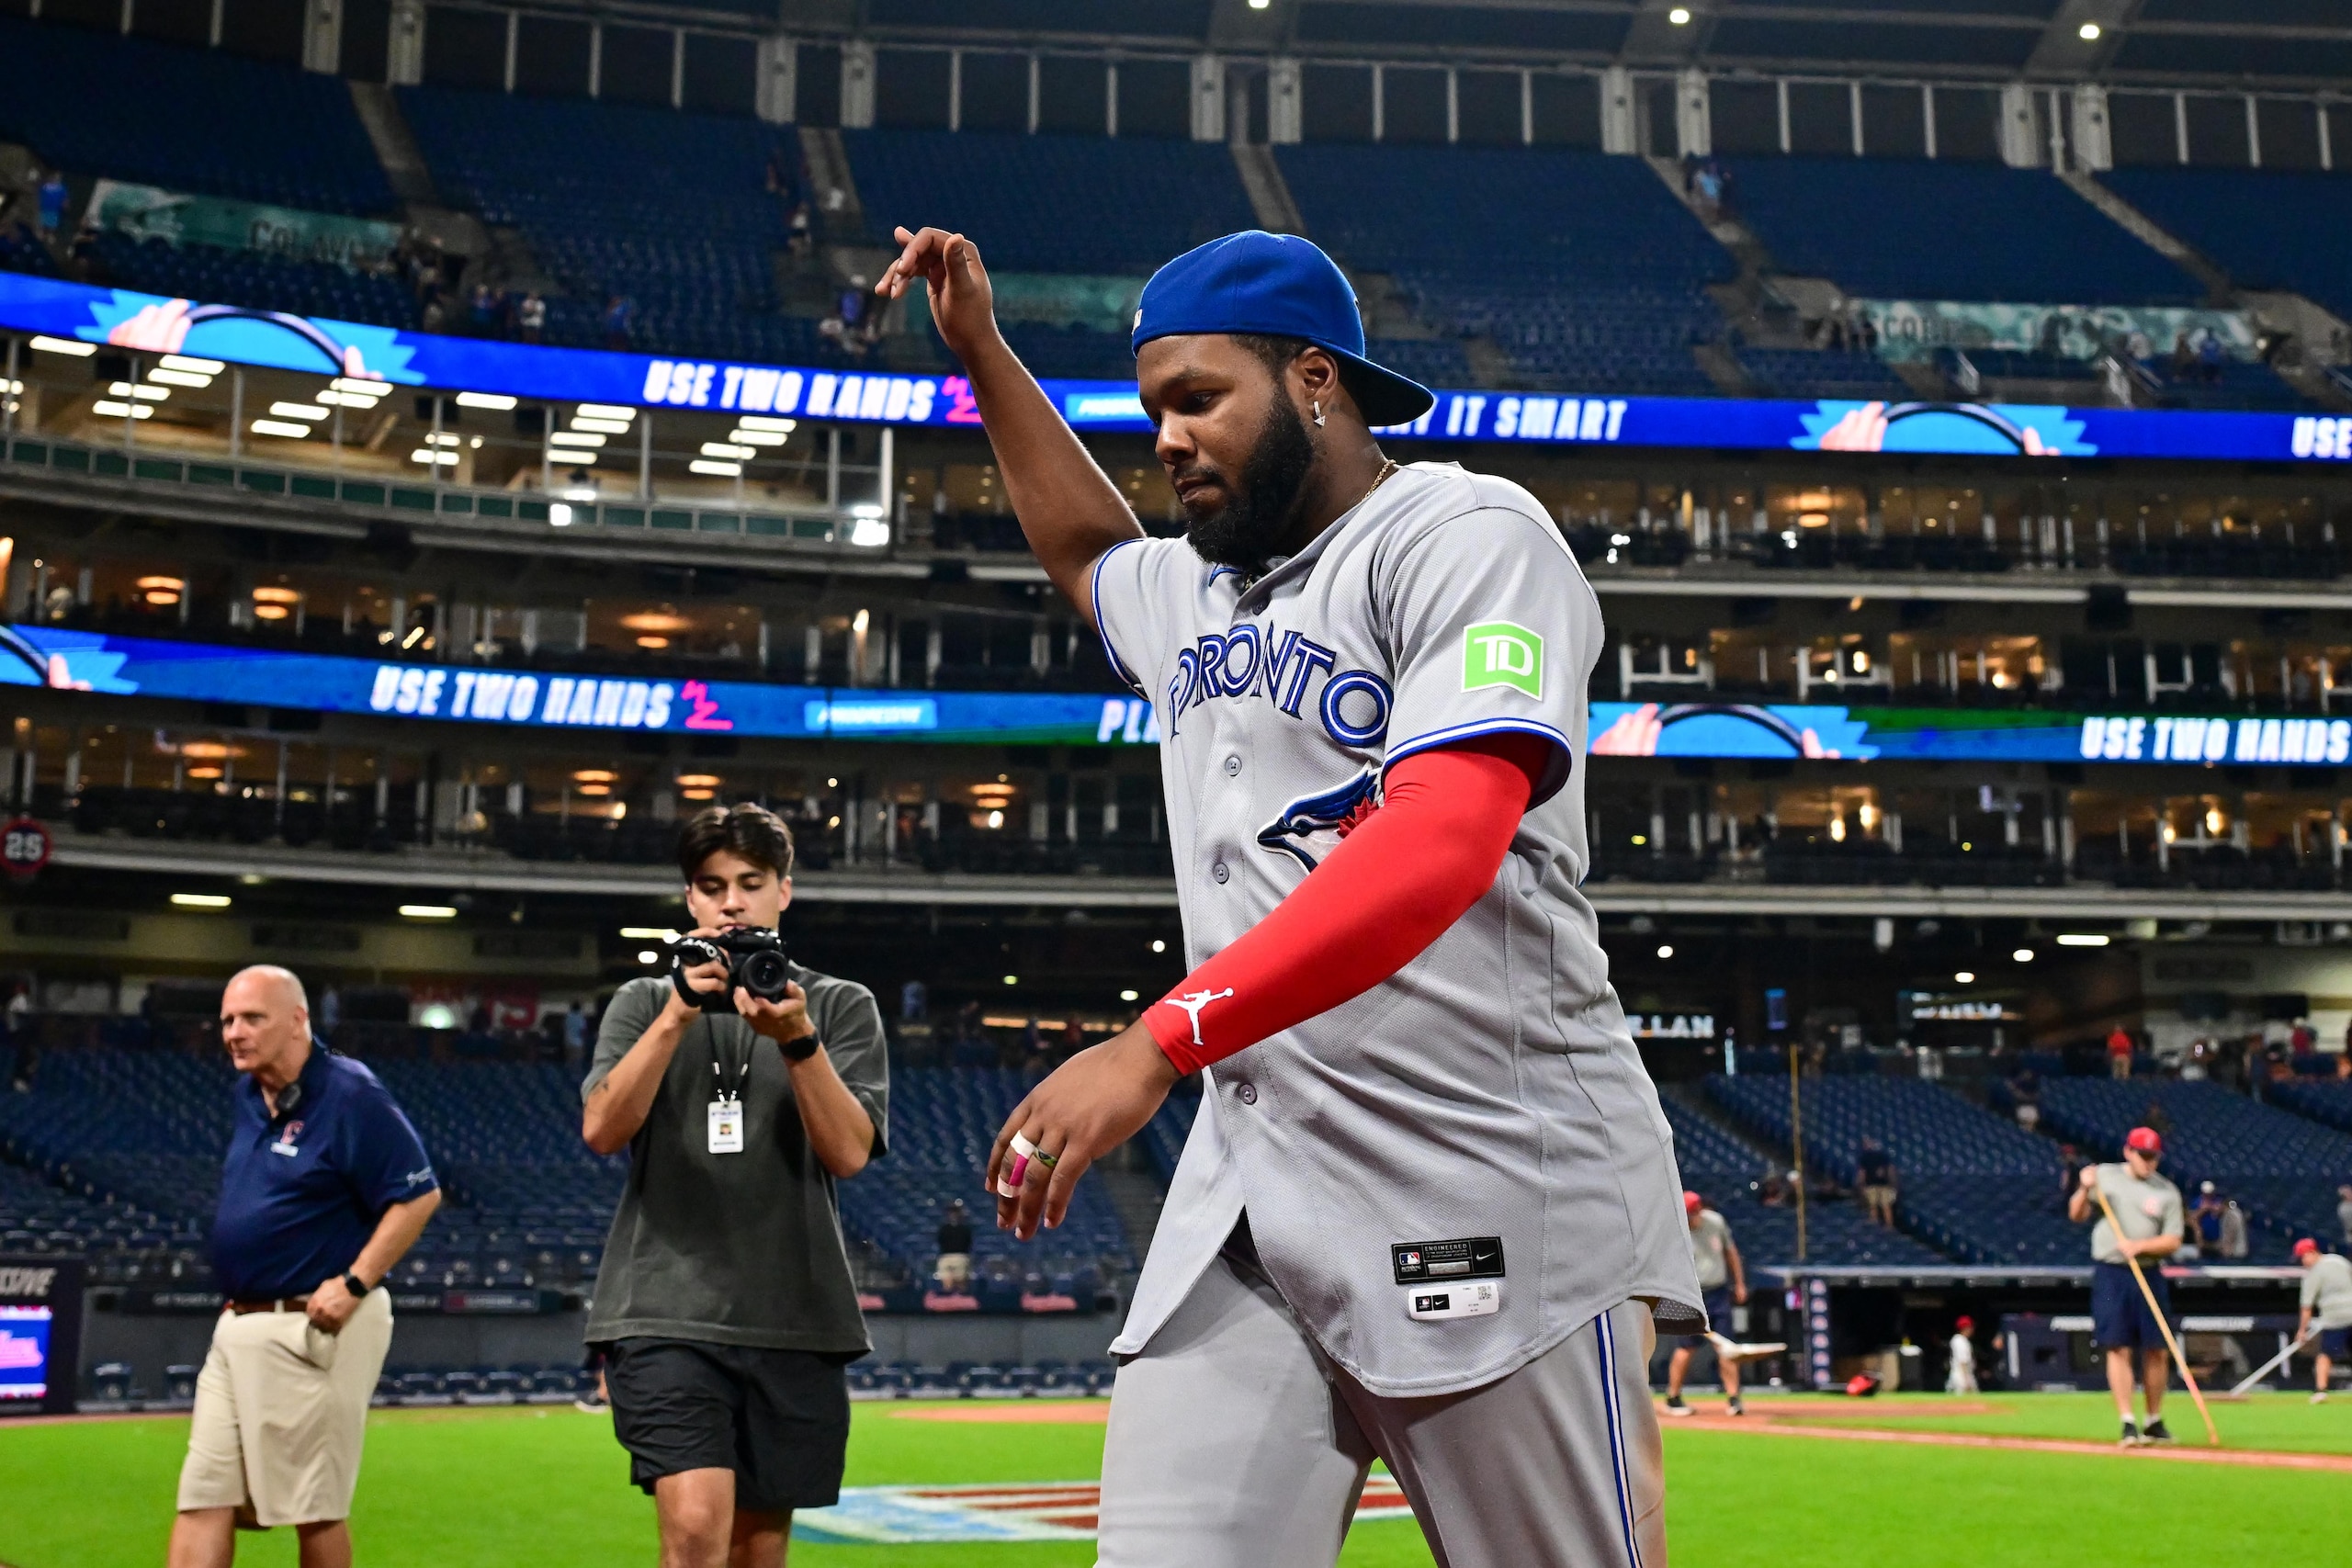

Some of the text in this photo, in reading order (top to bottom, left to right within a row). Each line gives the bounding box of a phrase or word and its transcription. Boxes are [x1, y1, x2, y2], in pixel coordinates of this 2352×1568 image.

[644, 359, 936, 423] USE TWO HANDS
[1445, 395, 1628, 441] IT SMART
[2291, 416, 2352, 458] USE
[1473, 634, 1534, 677] TD
[369, 664, 674, 728] USE TWO HANDS
[2080, 716, 2352, 763] USE TWO HANDS
[5, 832, 44, 861] 25
